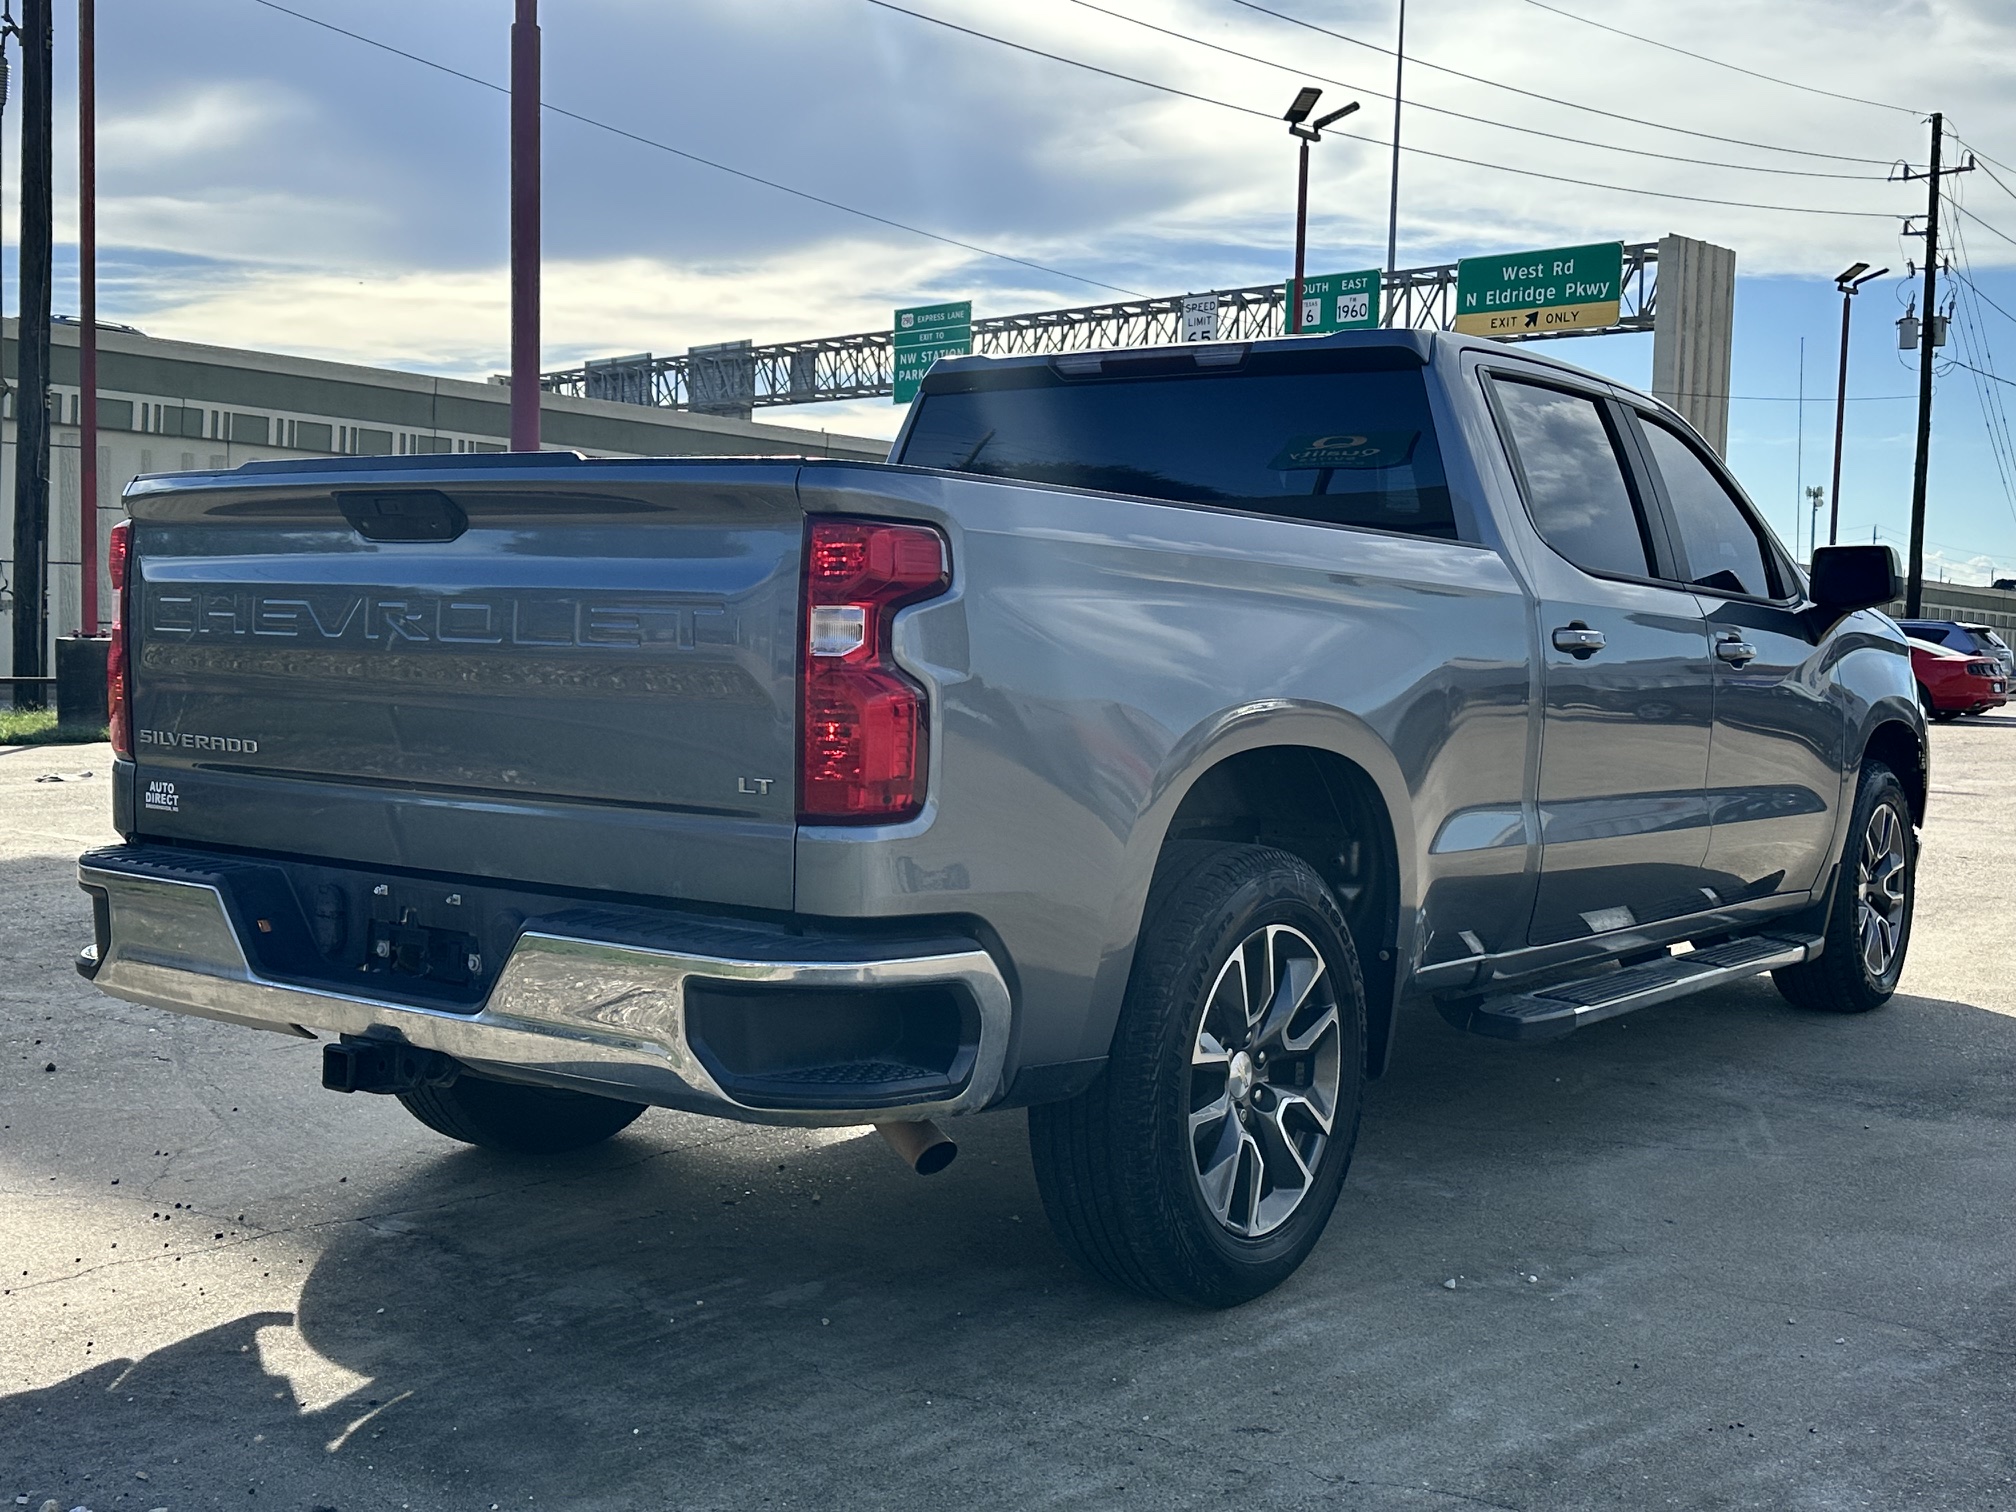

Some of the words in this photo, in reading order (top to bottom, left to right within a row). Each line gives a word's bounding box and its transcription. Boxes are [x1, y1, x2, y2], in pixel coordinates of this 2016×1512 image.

[1502, 263, 1544, 281] West
[1553, 259, 1574, 276] Rd
[1303, 282, 1329, 294] OUTH
[1341, 278, 1368, 290] EAST
[1466, 292, 1477, 307] N
[1485, 286, 1556, 305] Eldridge
[1565, 281, 1610, 298] Pkwy
[1185, 301, 1216, 313] SPEED
[1337, 303, 1368, 320] 1960
[917, 313, 945, 323] EXPRESS
[947, 310, 964, 320] LANE
[1187, 315, 1212, 327] LIMIT
[1305, 309, 1314, 323] 6
[1490, 317, 1518, 329] EXIT
[1545, 311, 1580, 324] ONLY
[919, 333, 933, 341] EXIT
[935, 332, 945, 340] TO
[900, 353, 917, 365] NW
[921, 347, 964, 363] STATION
[898, 368, 924, 381] PARK
[152, 596, 726, 651] CHEVROLET
[139, 729, 258, 754] SILVERADO
[149, 780, 175, 794] AUTO
[738, 777, 774, 795] LT
[145, 791, 179, 806] DIRECT
